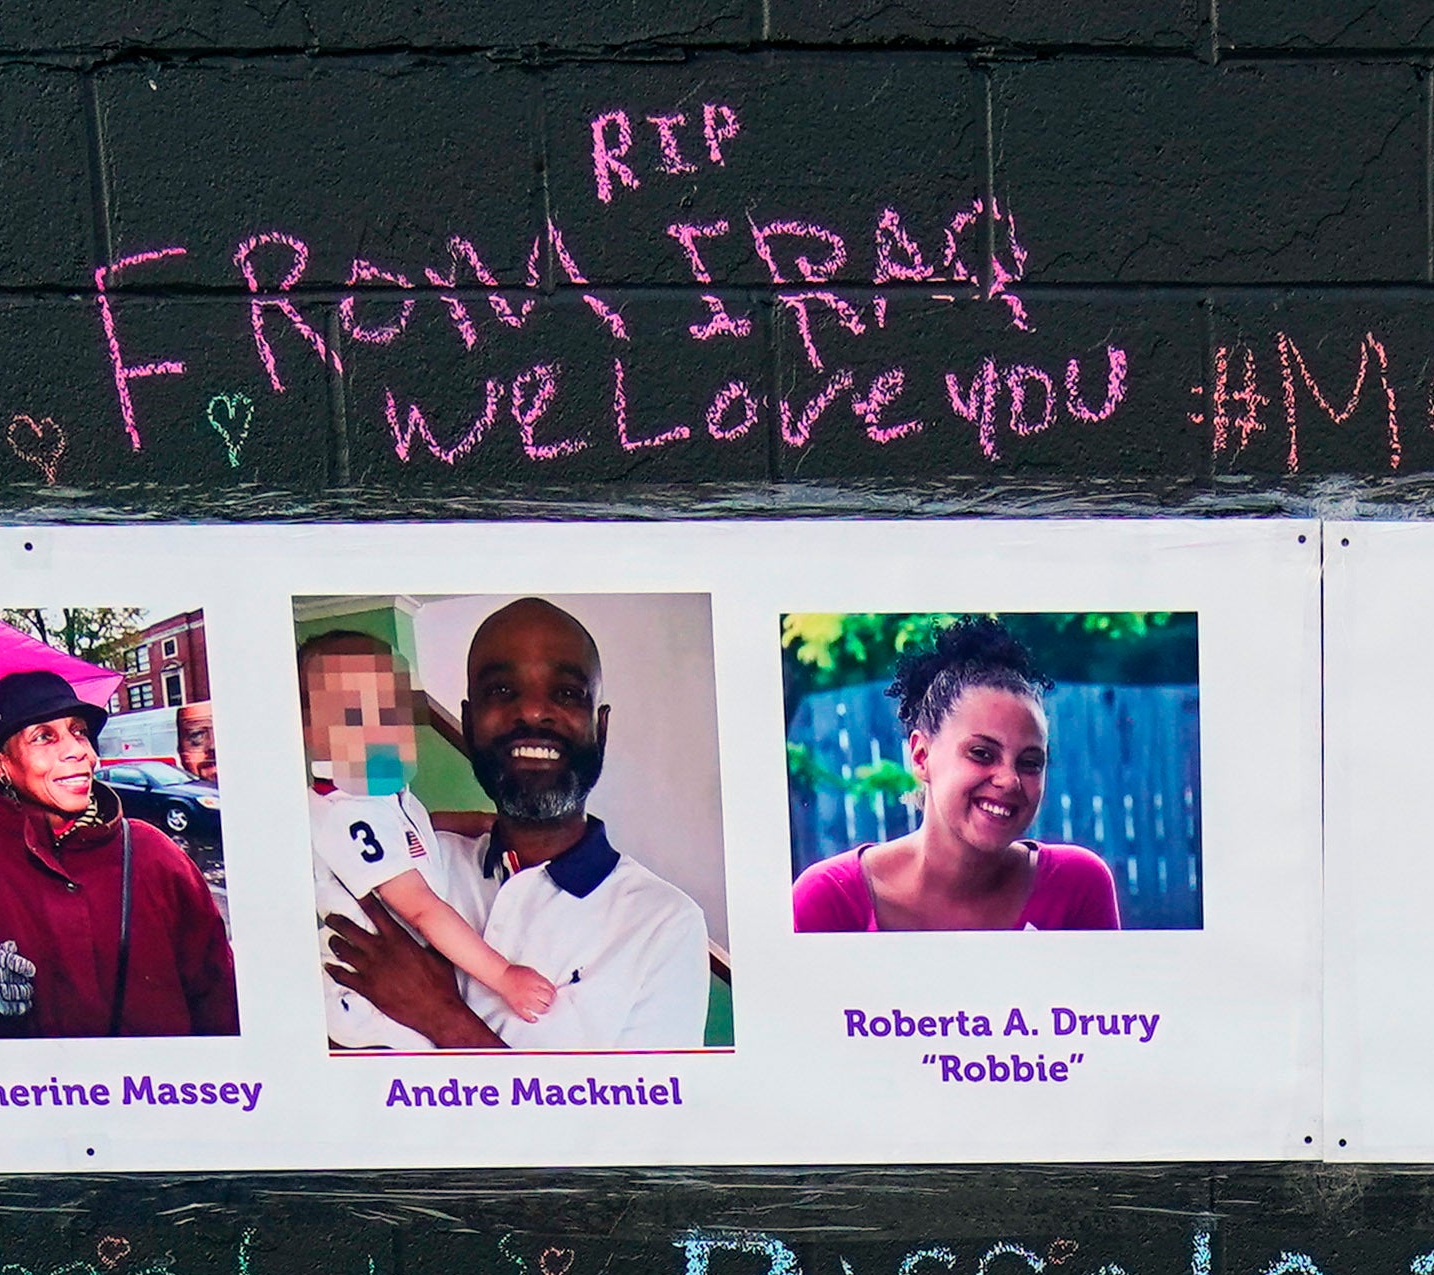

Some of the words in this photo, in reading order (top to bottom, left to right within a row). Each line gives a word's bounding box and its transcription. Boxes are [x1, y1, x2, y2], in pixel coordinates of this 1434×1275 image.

[590, 102, 741, 203] RIP
[352, 819, 386, 865] 3
[843, 1008, 993, 1038] Roberta
[1002, 1007, 1039, 1037] A.
[1050, 1007, 1161, 1057] Drury
[122, 1075, 263, 1113] Massey
[385, 1078, 500, 1108] Andre
[510, 1076, 683, 1107] Mackniel
